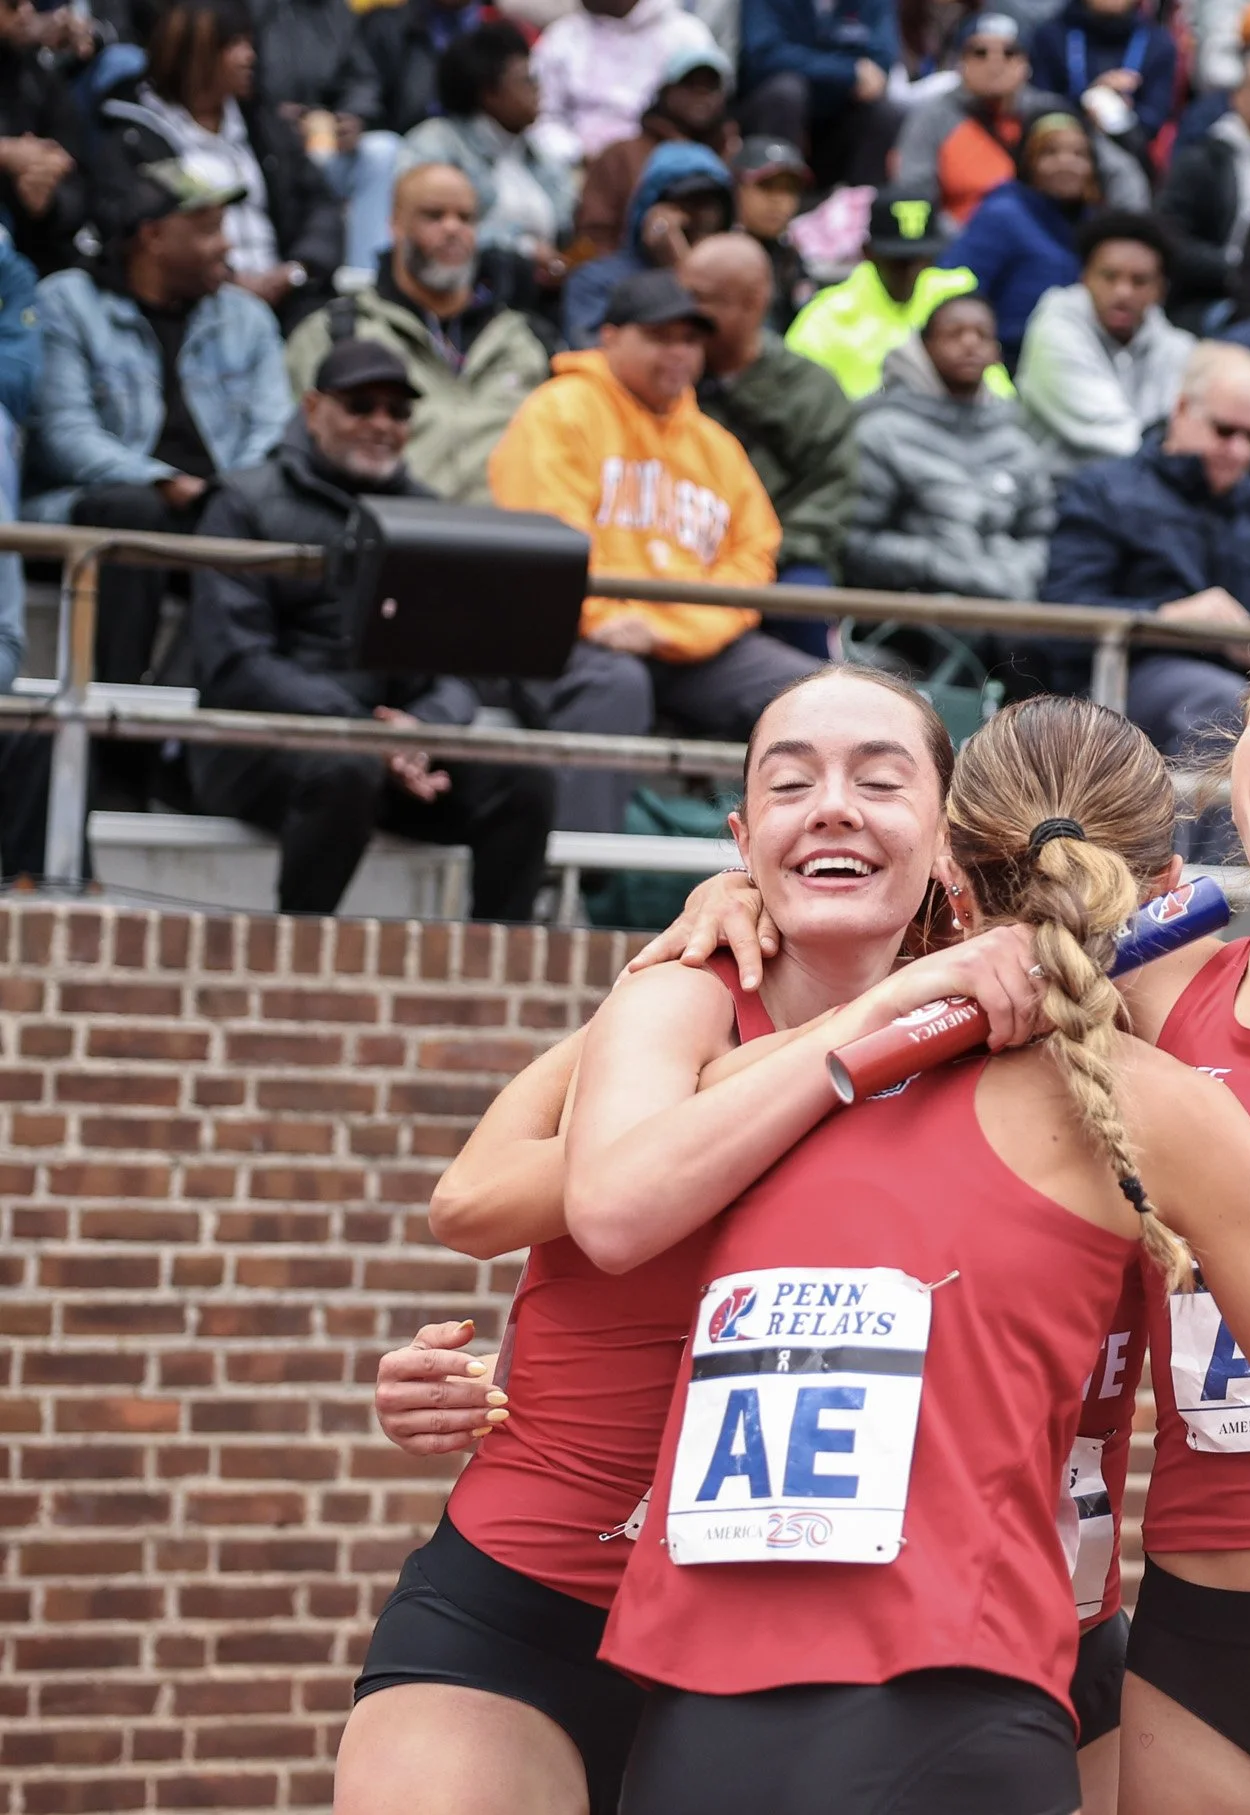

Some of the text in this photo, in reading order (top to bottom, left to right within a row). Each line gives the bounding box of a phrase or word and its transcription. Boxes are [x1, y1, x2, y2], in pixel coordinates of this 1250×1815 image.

[772, 1282, 868, 1307] PENN
[766, 1311, 896, 1336] RELAYS
[694, 1386, 867, 1502] AE
[704, 1511, 834, 1549] AMERICA 250
